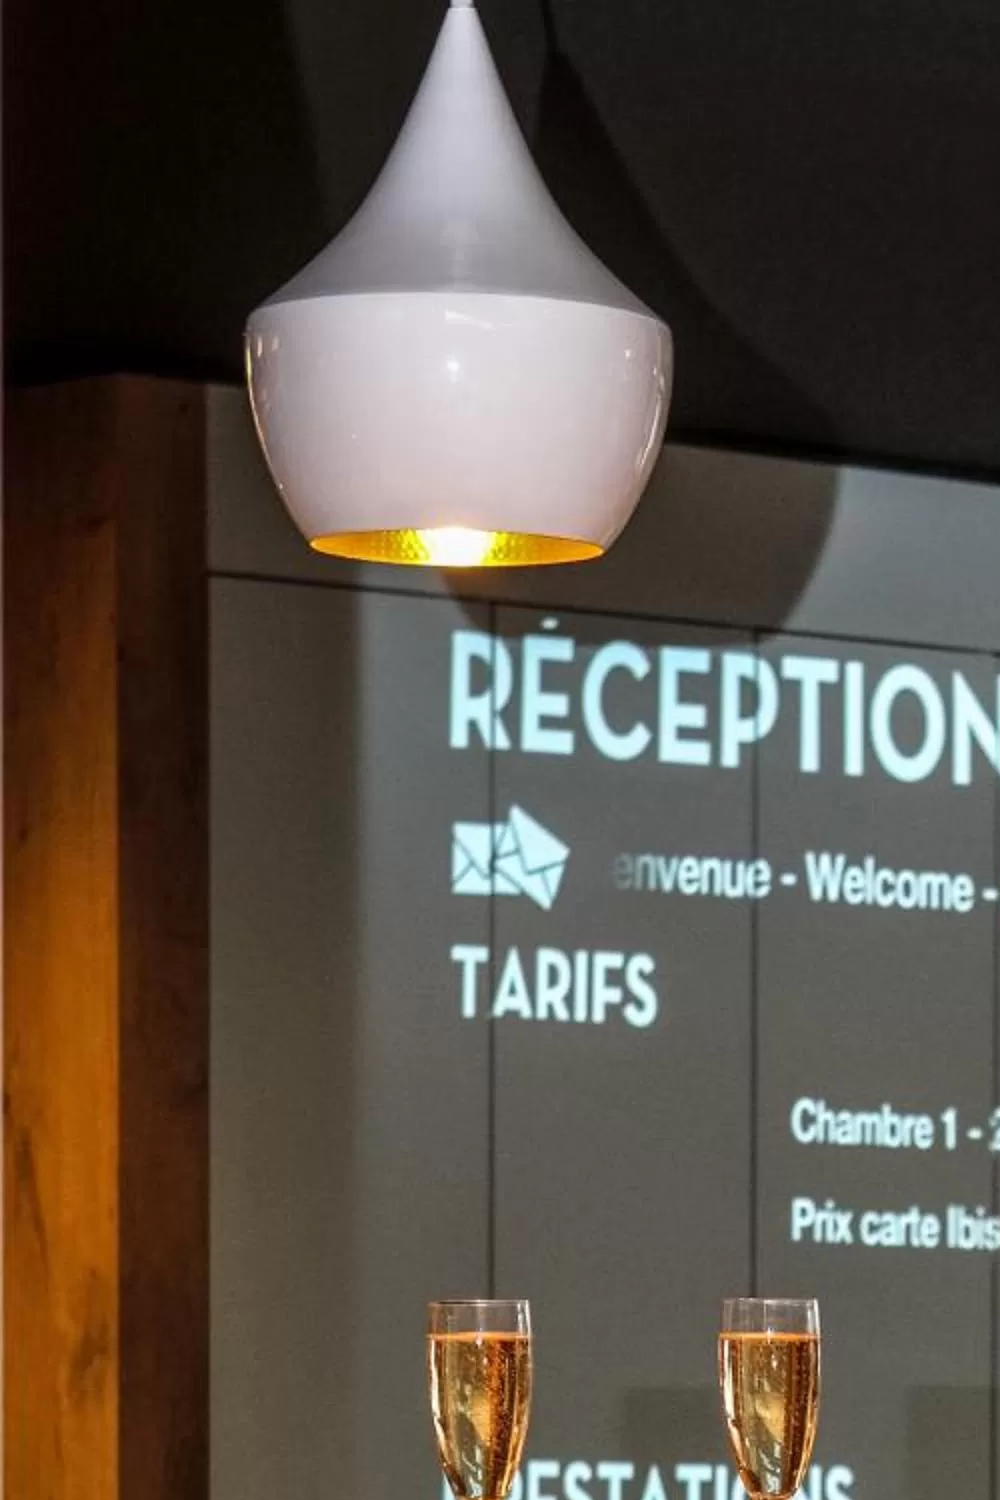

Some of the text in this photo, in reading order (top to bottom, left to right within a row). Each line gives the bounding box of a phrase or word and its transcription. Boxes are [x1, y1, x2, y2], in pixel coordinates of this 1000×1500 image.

[804, 850, 975, 914] Welcome
[450, 943, 658, 1028] TARIFS
[790, 1096, 934, 1151] Chambre
[940, 1106, 957, 1150] 1
[790, 1196, 853, 1245] Prix
[859, 1204, 941, 1249] carte
